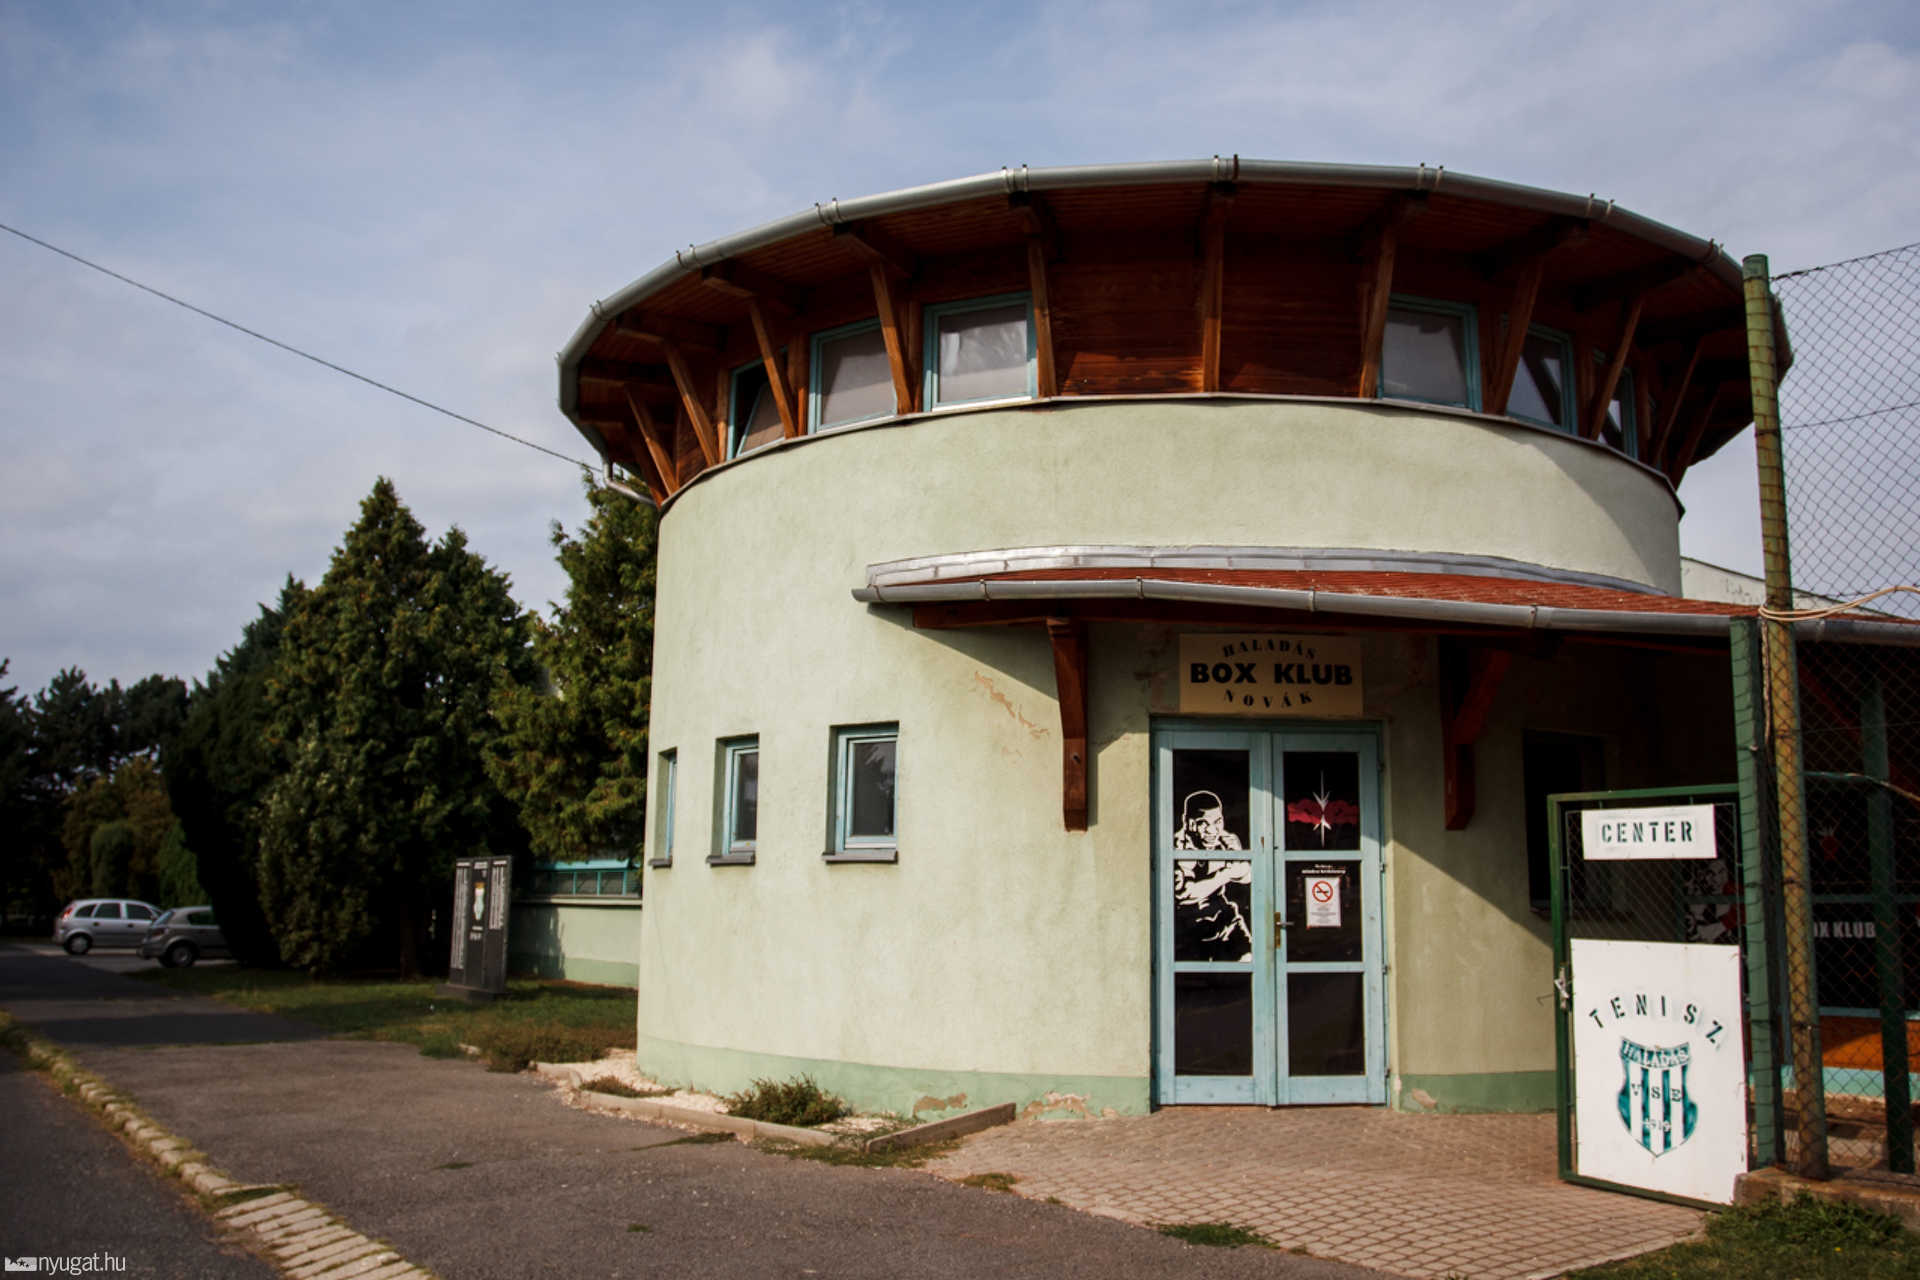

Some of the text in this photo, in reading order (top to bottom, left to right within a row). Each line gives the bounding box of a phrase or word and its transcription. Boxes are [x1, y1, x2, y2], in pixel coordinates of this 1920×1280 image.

[1222, 639, 1317, 660] HALADÁS
[1190, 662, 1353, 686] BOX KLUB
[1223, 689, 1313, 708] NOVÁK
[1601, 820, 1693, 844] CENTER
[1833, 921, 1876, 938] KLUB
[1589, 994, 1724, 1050] TENISZ
